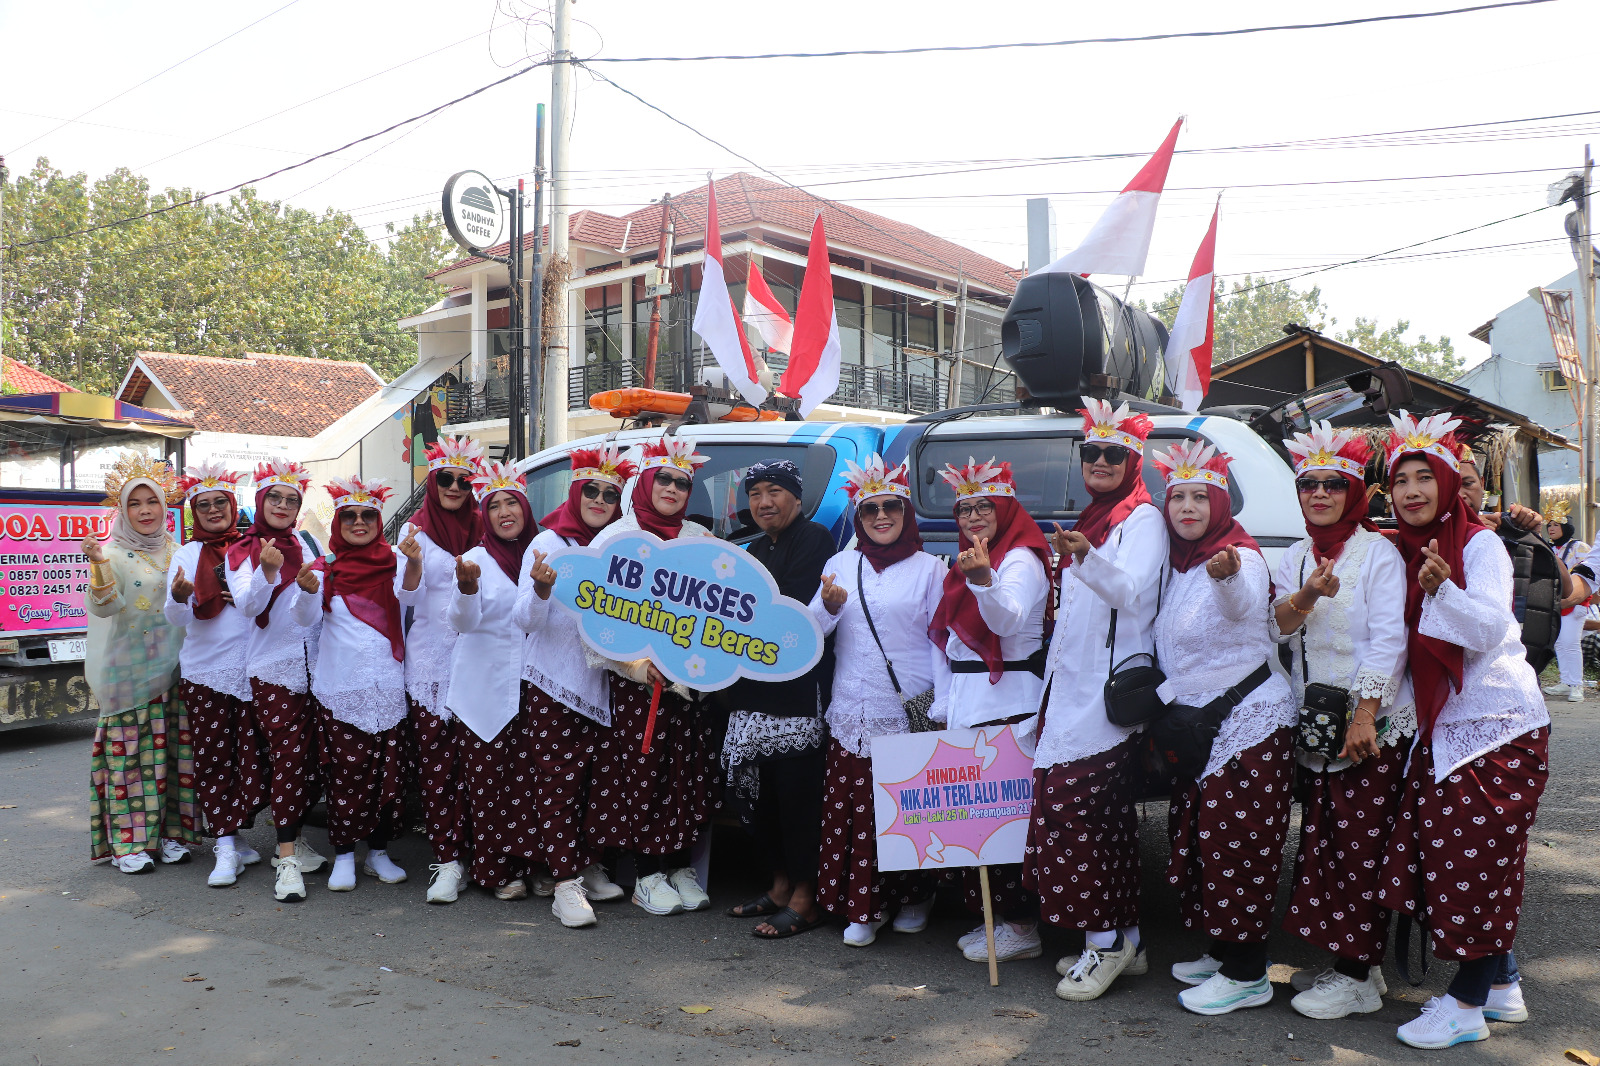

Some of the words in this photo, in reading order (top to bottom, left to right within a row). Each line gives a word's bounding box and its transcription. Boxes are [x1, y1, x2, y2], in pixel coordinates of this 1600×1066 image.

[461, 208, 495, 228] SANDHYA
[466, 222, 491, 239] COFFEE
[0, 513, 53, 541] OA
[57, 514, 111, 541] IBU
[43, 553, 90, 565] CARTER
[8, 570, 39, 581] 0857
[42, 569, 72, 580] 0005
[9, 585, 39, 596] 0823
[43, 584, 71, 594] 2451
[606, 554, 644, 590] KB
[650, 568, 757, 623] SUKSES
[52, 601, 86, 618] Trans
[575, 580, 697, 649] Stunting
[701, 616, 780, 665] Beres
[51, 642, 58, 654] B
[926, 764, 981, 786] HINDARI
[900, 787, 941, 812] NIKAH
[943, 781, 998, 807] TERLALU
[1001, 778, 1034, 802] MUD
[904, 811, 922, 825] Laki
[927, 809, 945, 823] Laki
[946, 809, 957, 821] 25
[958, 808, 968, 820] Th
[969, 804, 1017, 819] Perempuan
[1018, 803, 1030, 815] 21
